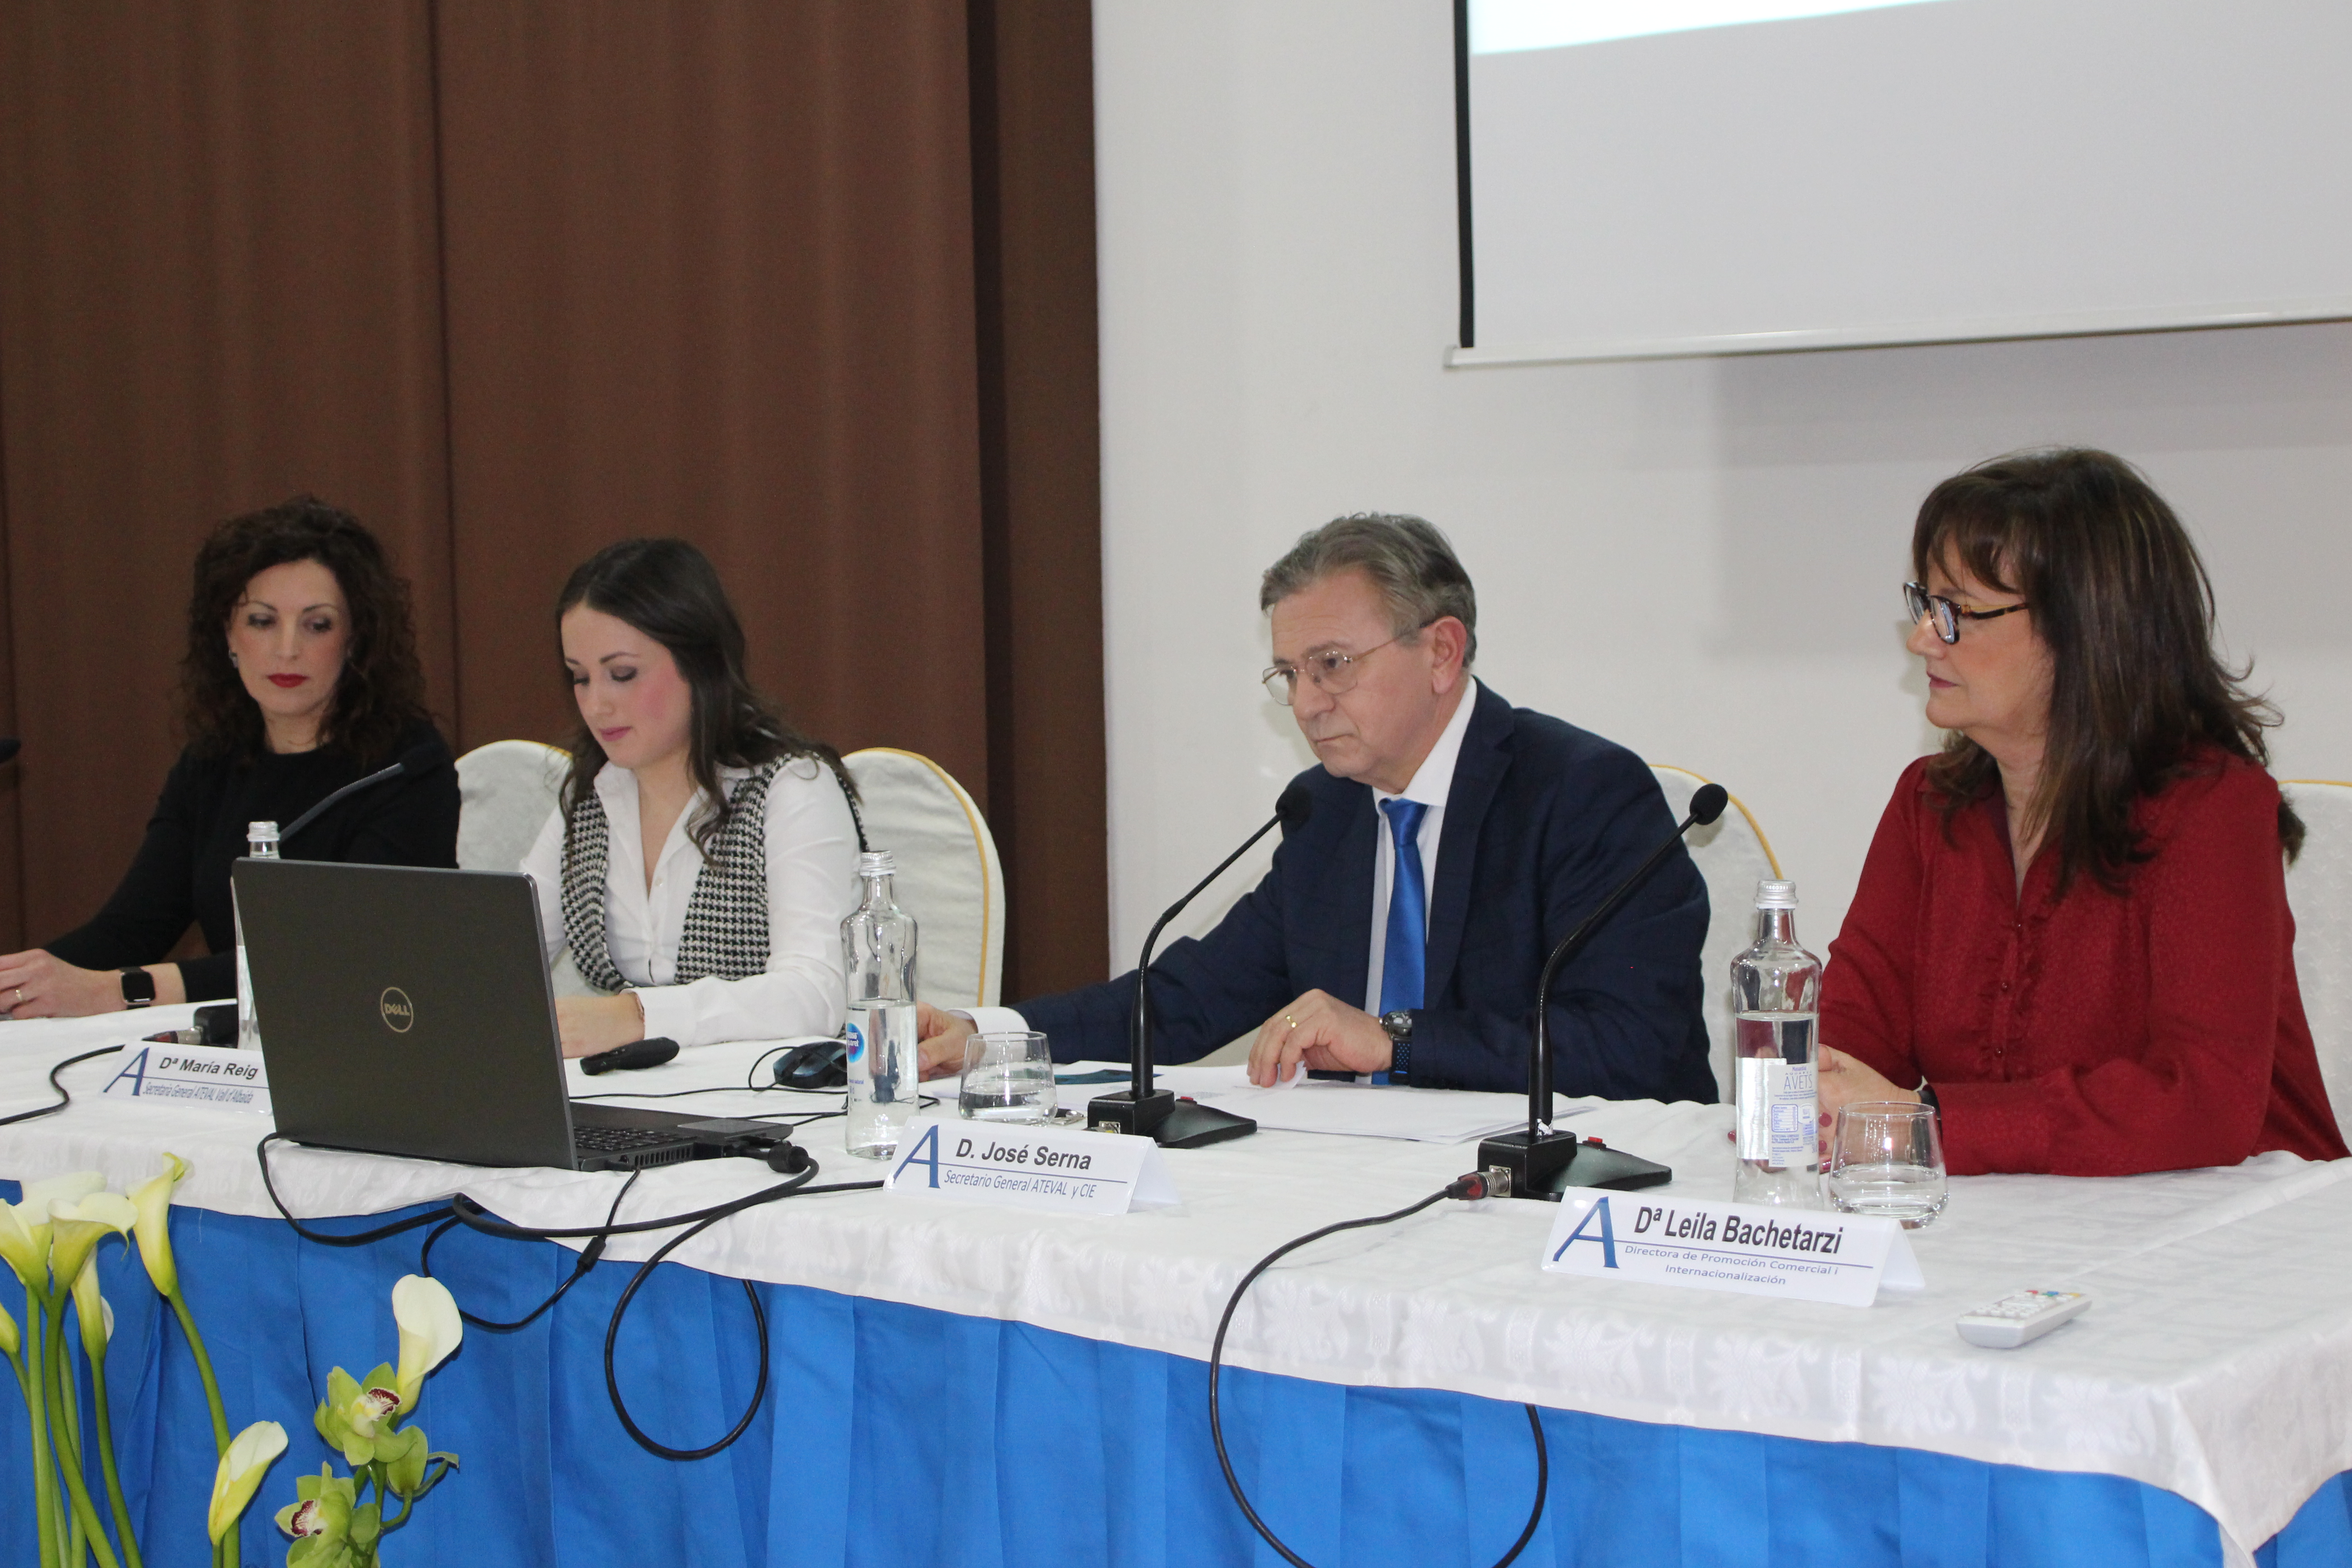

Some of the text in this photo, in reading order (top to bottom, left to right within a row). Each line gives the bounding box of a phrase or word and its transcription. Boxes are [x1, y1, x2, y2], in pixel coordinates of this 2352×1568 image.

[384, 1003, 410, 1016] DELL
[179, 1059, 220, 1074] María
[223, 1063, 259, 1080] Reig
[171, 1084, 197, 1098] General
[192, 1087, 215, 1100] ATEVAL
[1784, 1074, 1813, 1090] AVETS
[956, 1138, 1092, 1170] D. José Serna
[944, 1170, 1097, 1200] Secretario General ATEVAL y CIE
[1664, 1210, 1717, 1241] Leila
[1722, 1215, 1844, 1254] Bachetarzi
[1625, 1245, 1679, 1258] Directora
[1682, 1251, 1697, 1260] de
[1701, 1254, 1766, 1268] Promoción
[1770, 1260, 1832, 1275] Comercial
[1666, 1264, 1786, 1284] Internacionalización
